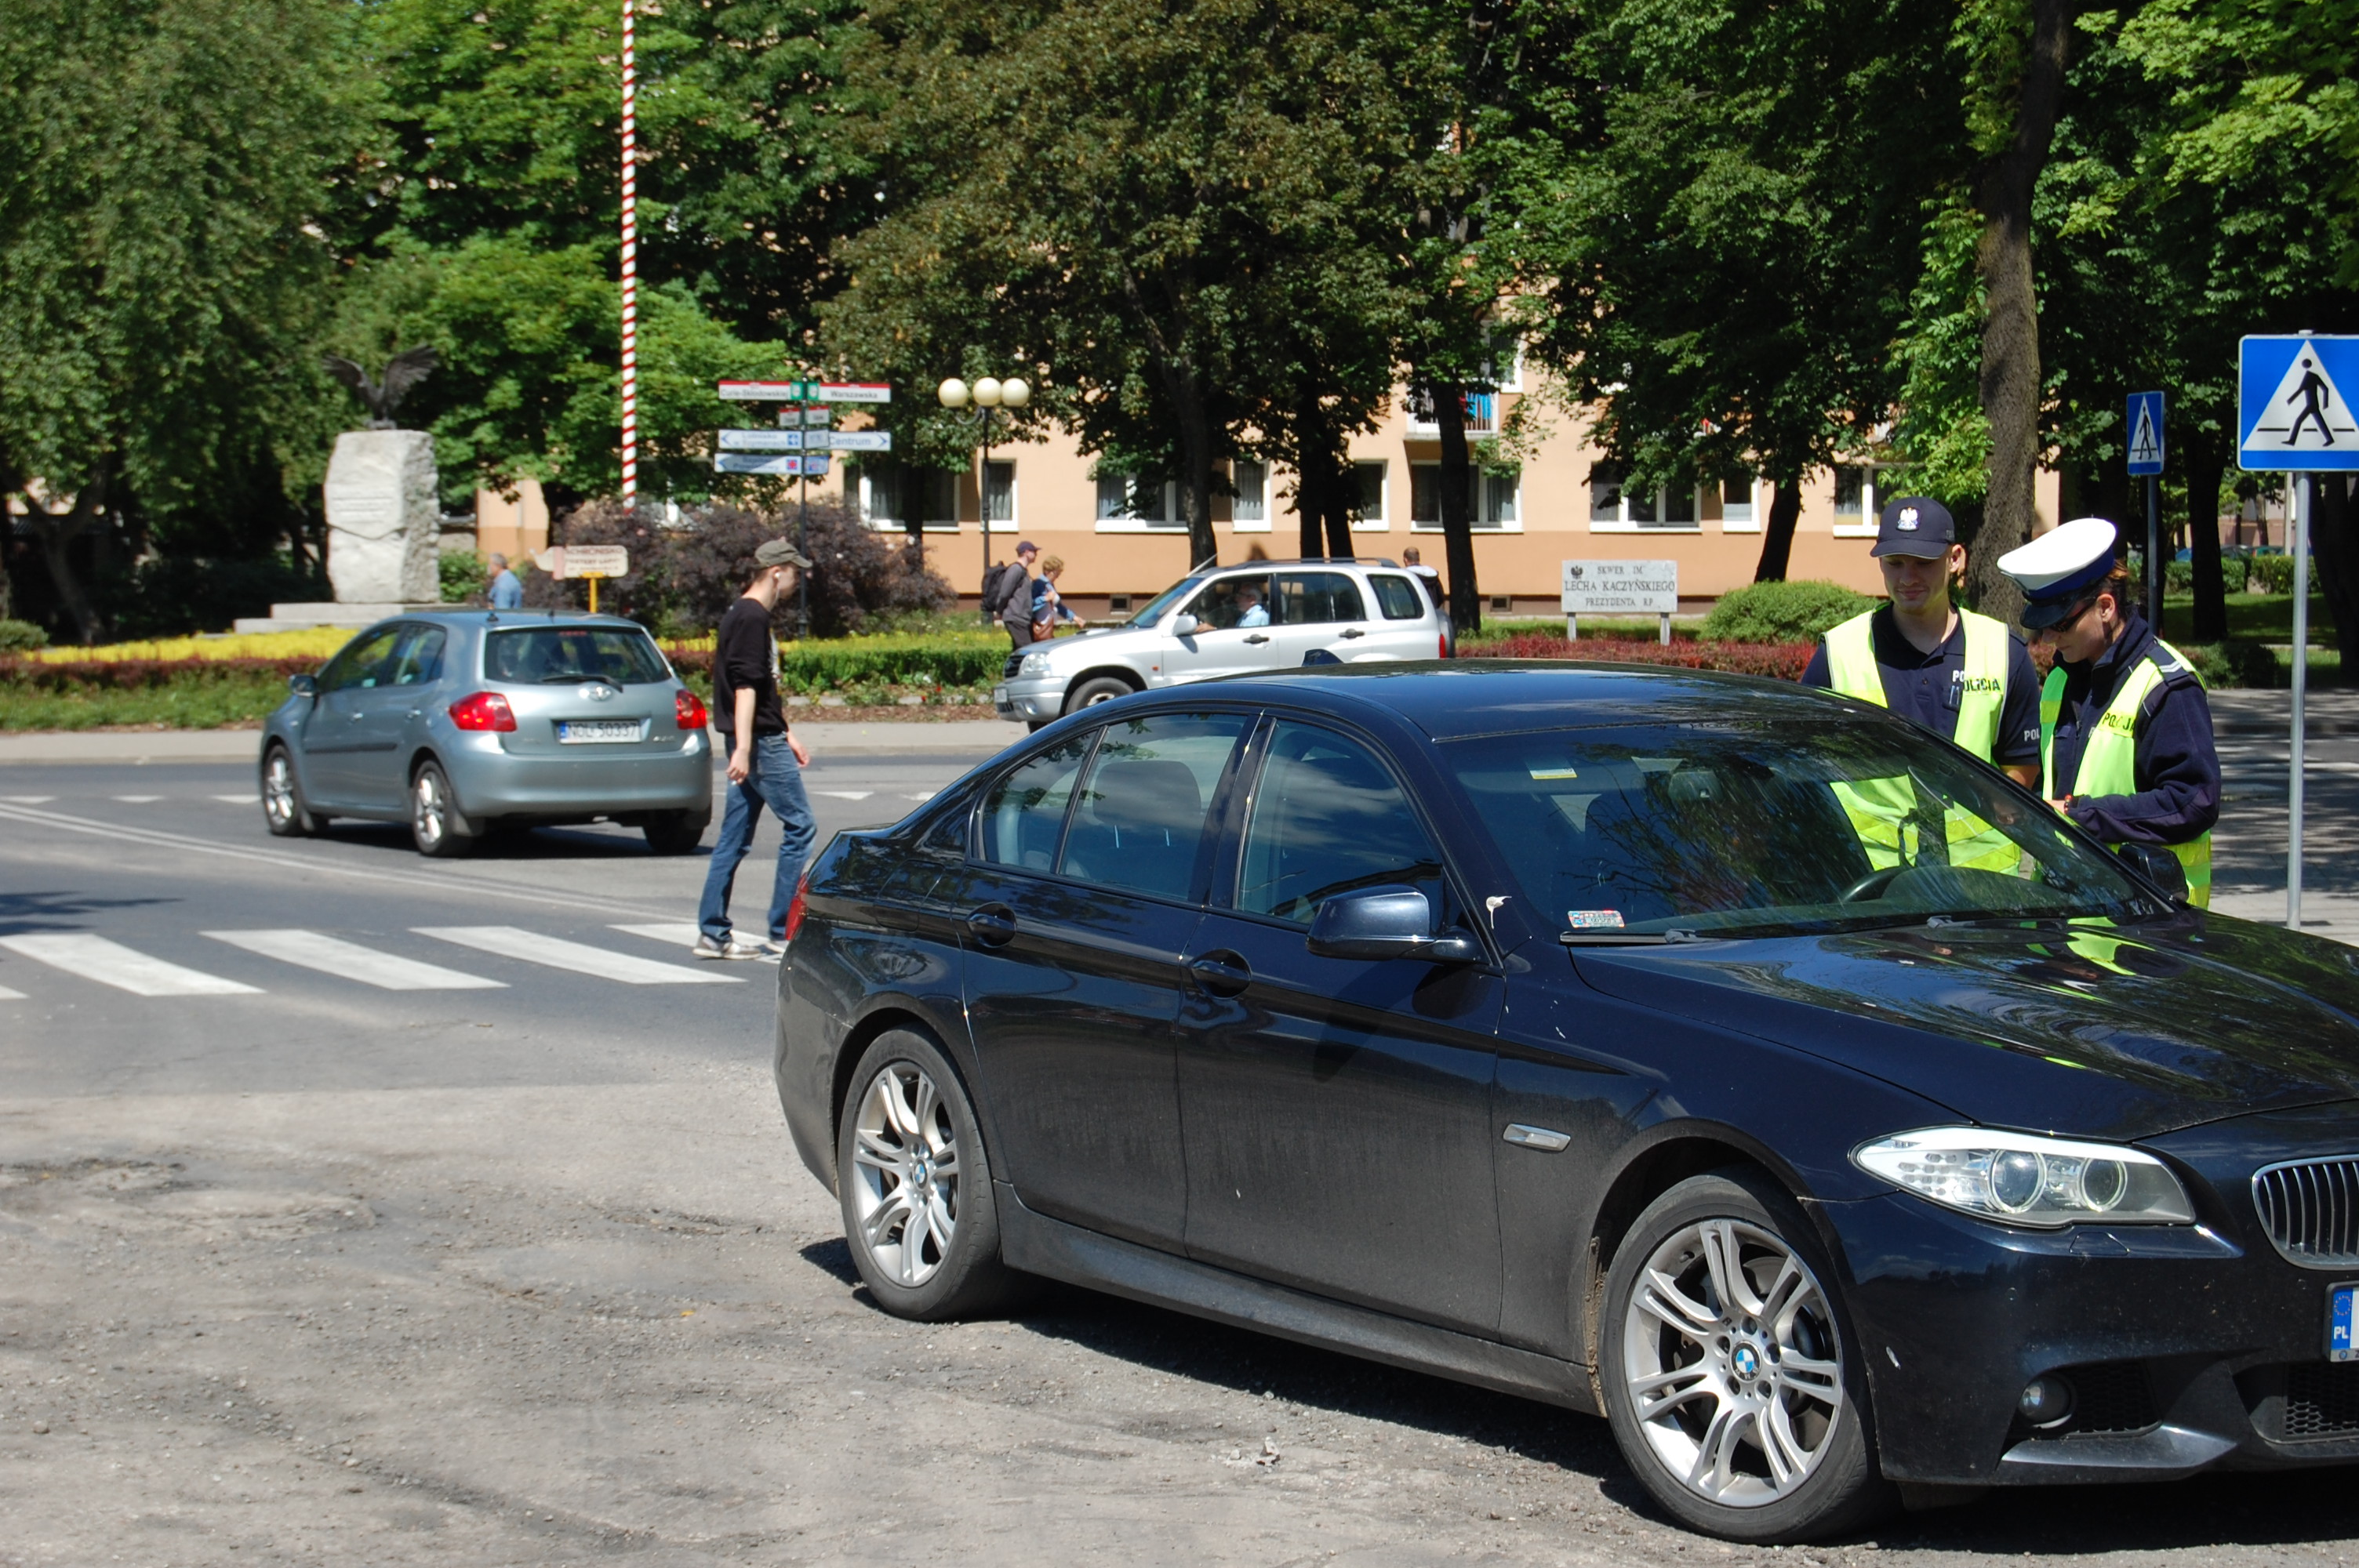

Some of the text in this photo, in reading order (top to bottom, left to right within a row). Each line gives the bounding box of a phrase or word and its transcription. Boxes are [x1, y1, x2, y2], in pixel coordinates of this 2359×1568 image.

[831, 390, 878, 398] Warszawska
[830, 436, 871, 445] Centrum
[1598, 566, 1624, 575] SKWER
[1565, 579, 1675, 591] LECHA KACZYŃSKIEGO
[1586, 597, 1653, 606] PREZYDENTA RP
[598, 722, 637, 737] 50337
[2333, 1326, 2348, 1340] PL
